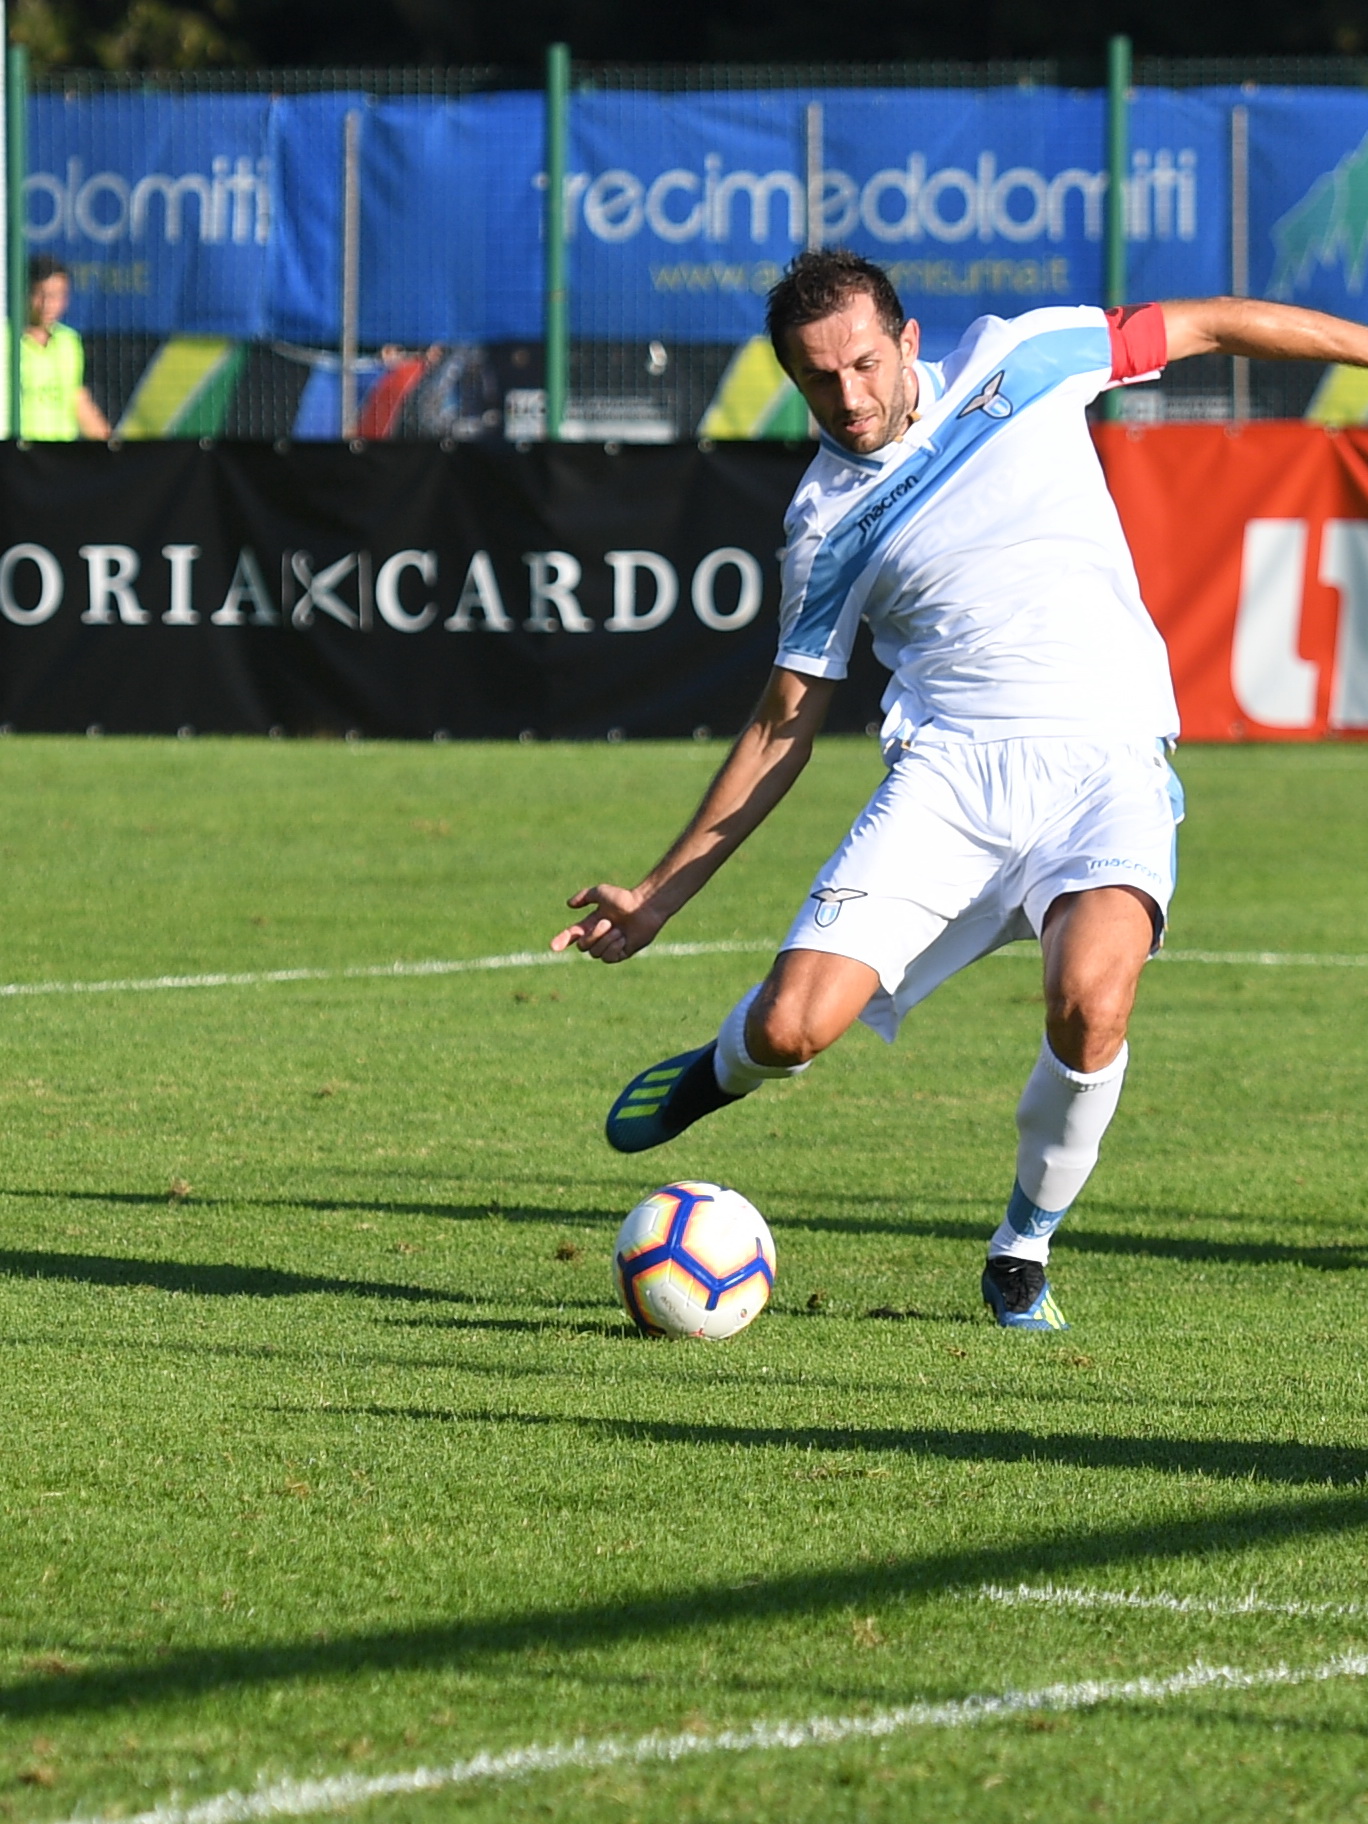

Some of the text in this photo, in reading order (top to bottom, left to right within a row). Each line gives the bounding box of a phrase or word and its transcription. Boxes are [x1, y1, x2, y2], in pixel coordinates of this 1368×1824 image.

[532, 148, 1198, 244] recimedolomiti
[857, 474, 920, 540] macron
[376, 547, 786, 634] CARDO
[1090, 857, 1163, 884] macron
